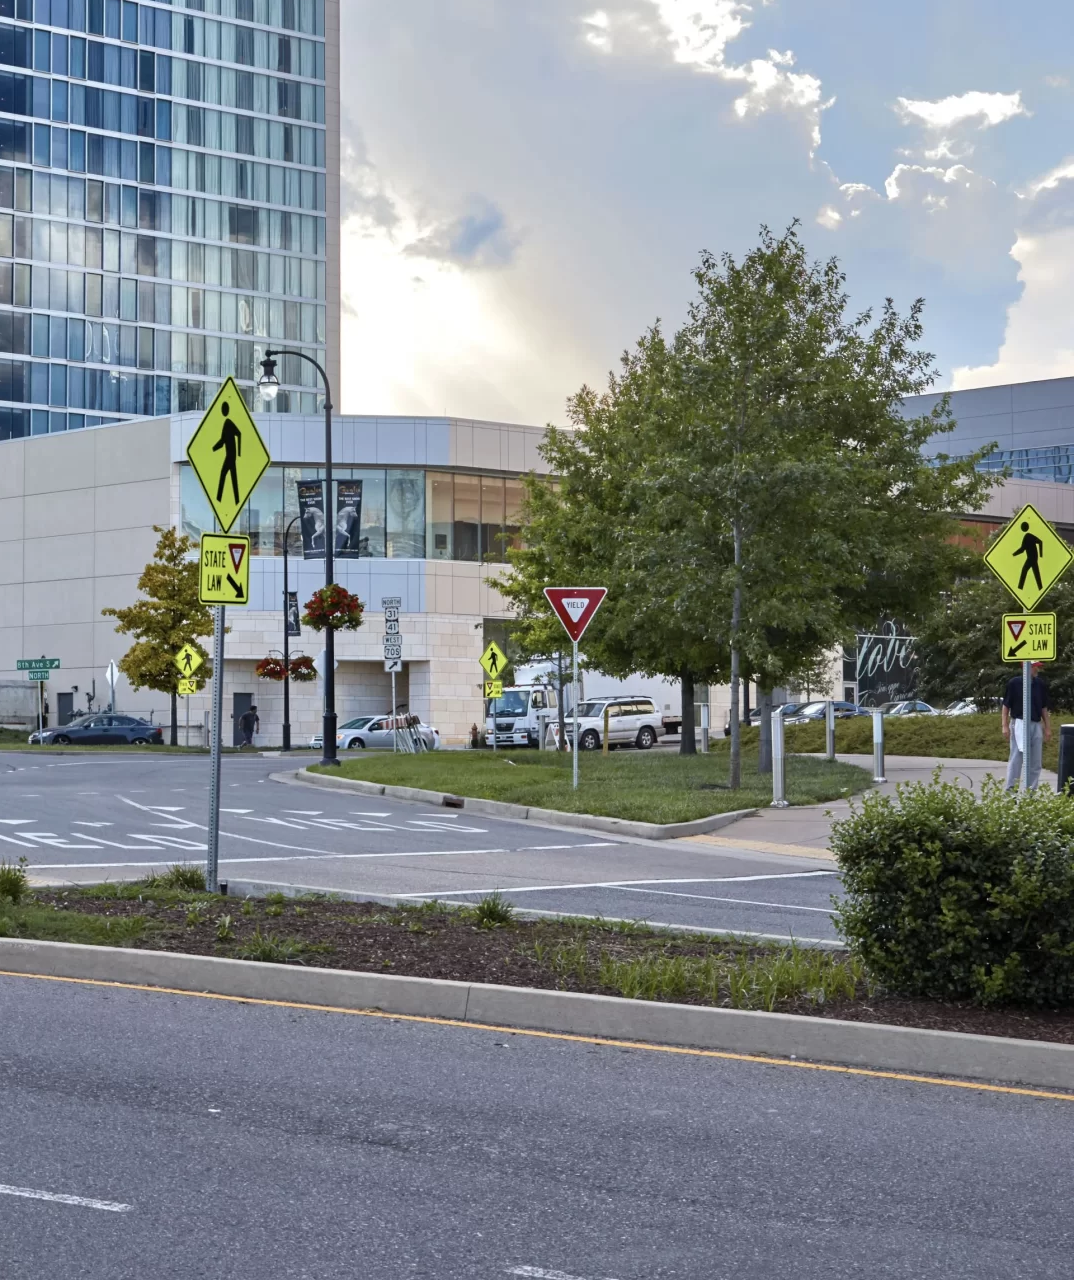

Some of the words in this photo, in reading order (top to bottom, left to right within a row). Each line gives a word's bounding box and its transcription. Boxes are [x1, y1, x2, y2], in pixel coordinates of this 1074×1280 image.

[204, 550, 226, 568] STATE
[207, 574, 223, 591] LAW
[382, 599, 401, 607] NORTH
[566, 601, 585, 609] YIELD
[387, 610, 396, 618] 31
[387, 623, 397, 631] 41
[1028, 623, 1052, 636] STATE
[385, 636, 400, 644] WEST
[1032, 639, 1048, 652] LAW
[386, 648, 400, 656] 70S
[31, 661, 44, 669] Ave
[45, 660, 51, 668] S
[29, 671, 49, 680] NORTH
[232, 814, 489, 833] YIELD
